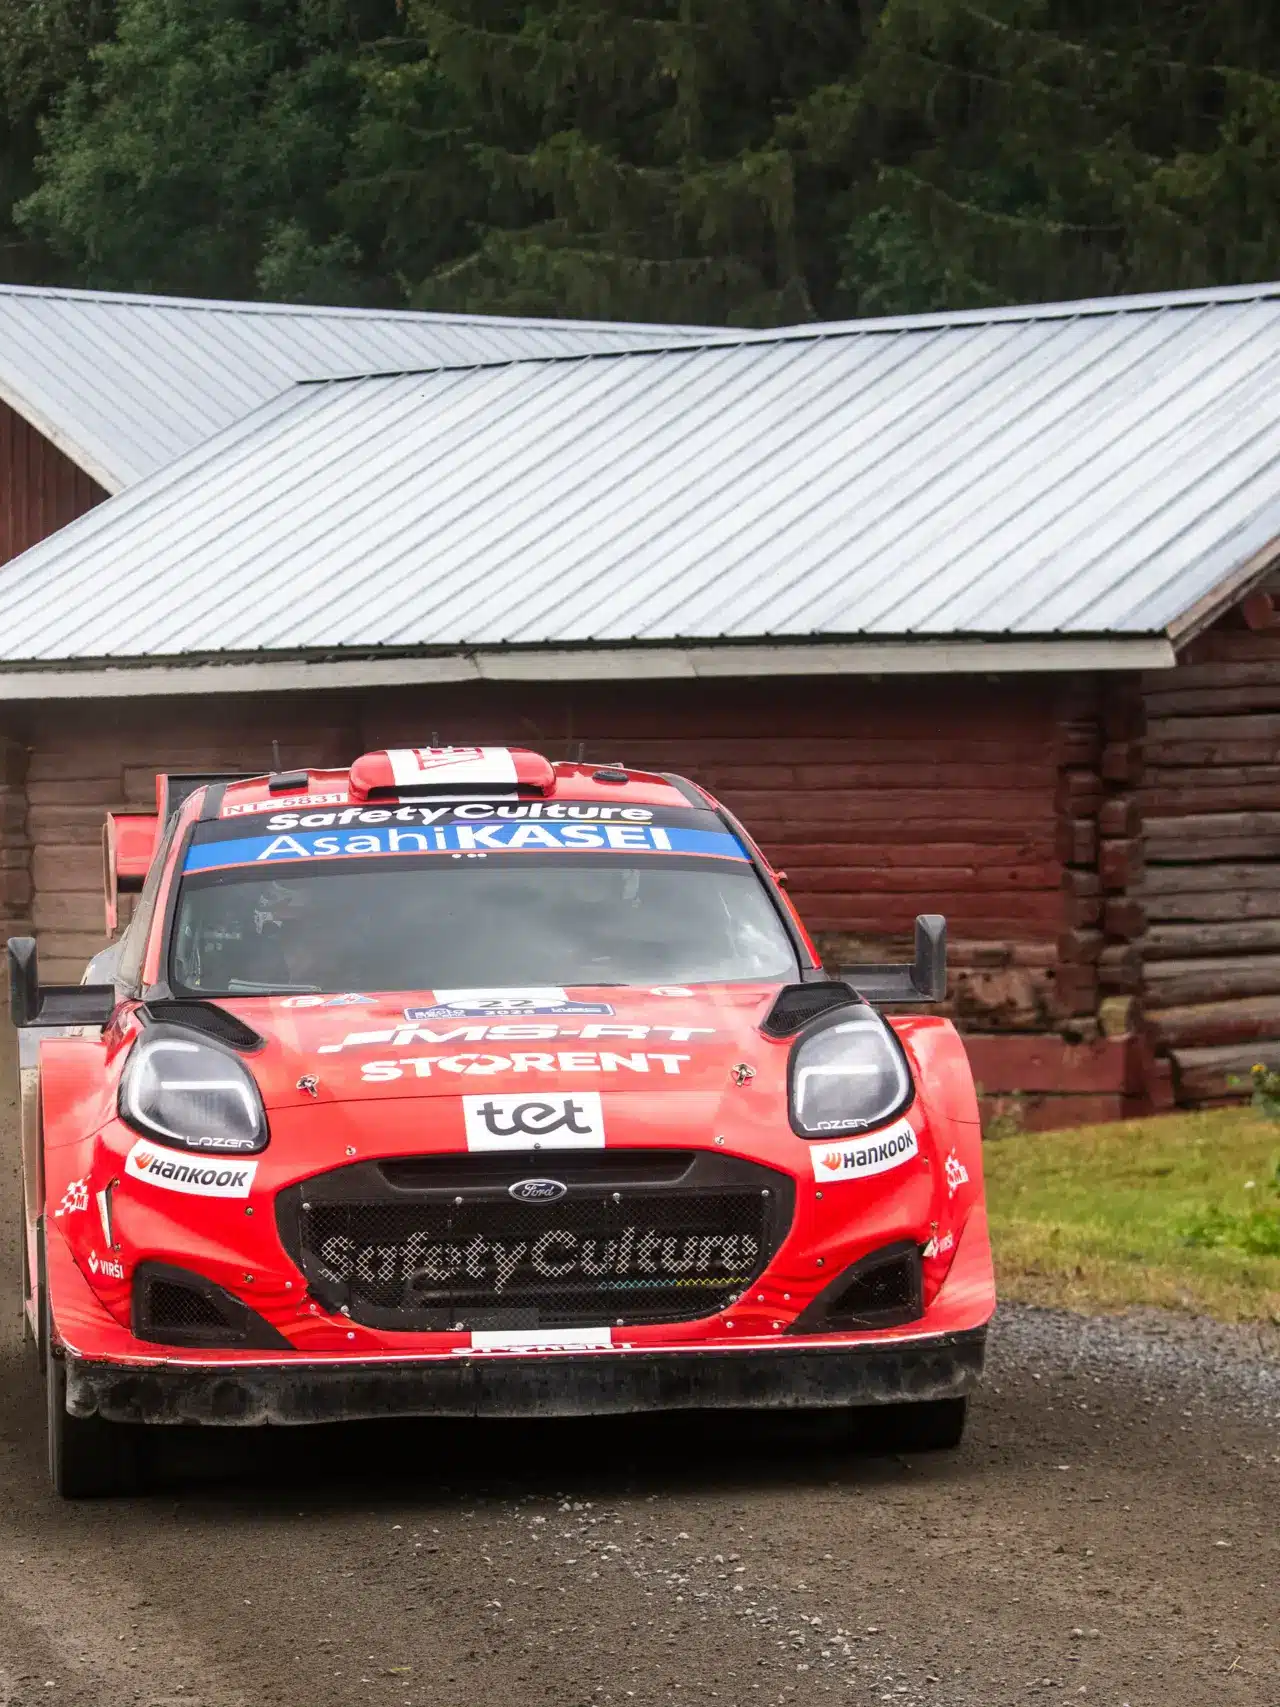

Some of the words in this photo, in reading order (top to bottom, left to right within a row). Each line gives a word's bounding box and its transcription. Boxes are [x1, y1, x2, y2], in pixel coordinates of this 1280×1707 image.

[266, 803, 653, 830] SafetyCulture
[479, 999, 535, 1008] 22
[361, 1052, 691, 1082] STORENT
[476, 1099, 593, 1136] tet
[803, 1118, 869, 1131] LAZER
[185, 1136, 255, 1148] LAZER
[521, 1183, 555, 1198] Ford
[100, 1259, 124, 1279] VIRŠI
